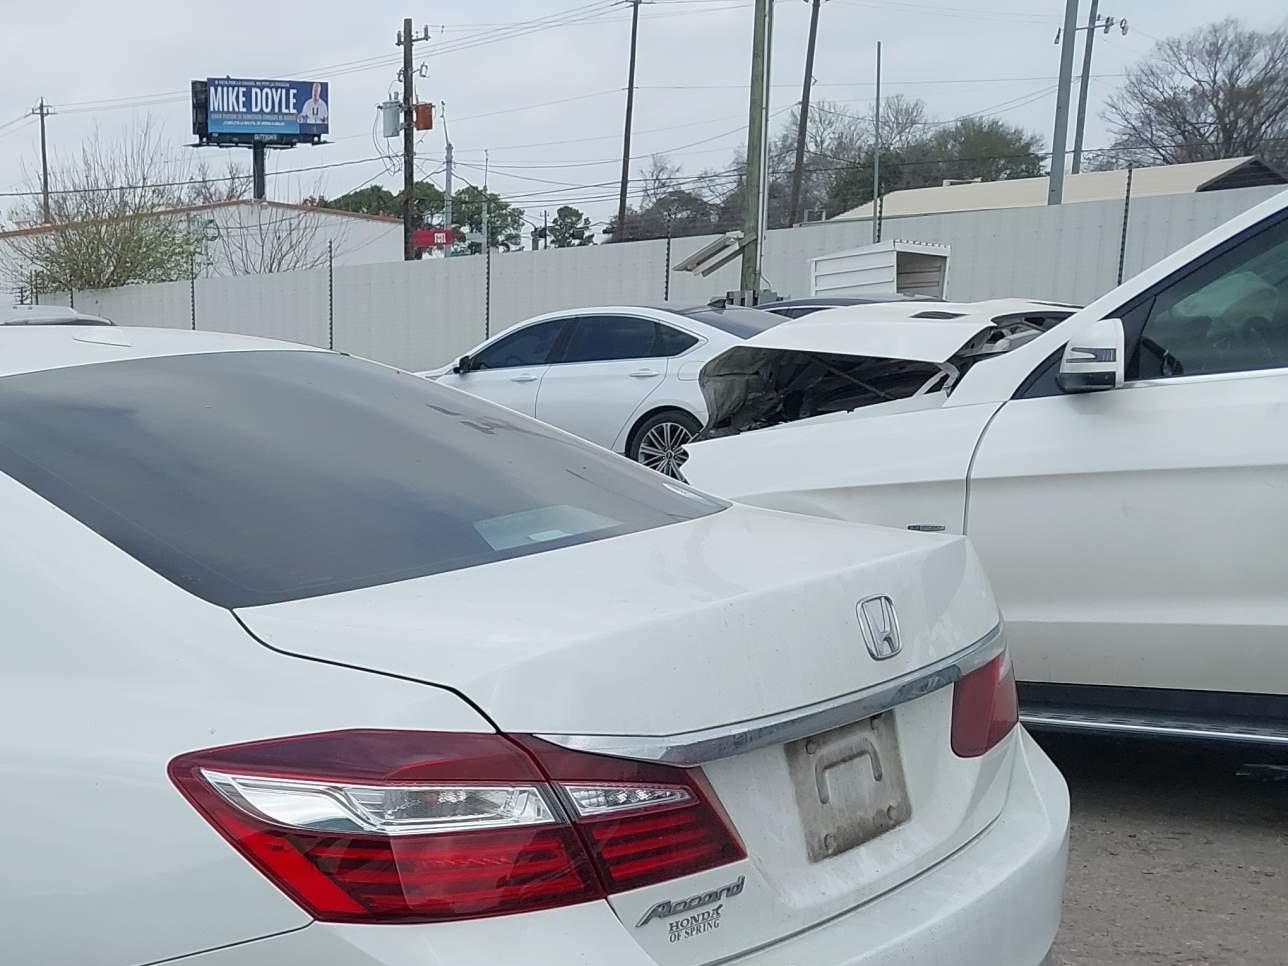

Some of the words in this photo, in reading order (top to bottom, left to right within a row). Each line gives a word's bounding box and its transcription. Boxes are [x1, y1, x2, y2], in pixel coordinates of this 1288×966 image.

[209, 86, 247, 113] MIKE
[252, 87, 298, 114] DOYLE
[634, 875, 746, 929] Accord
[668, 904, 724, 932] HONDA
[669, 932, 682, 944] OF
[684, 919, 720, 939] SPRING
